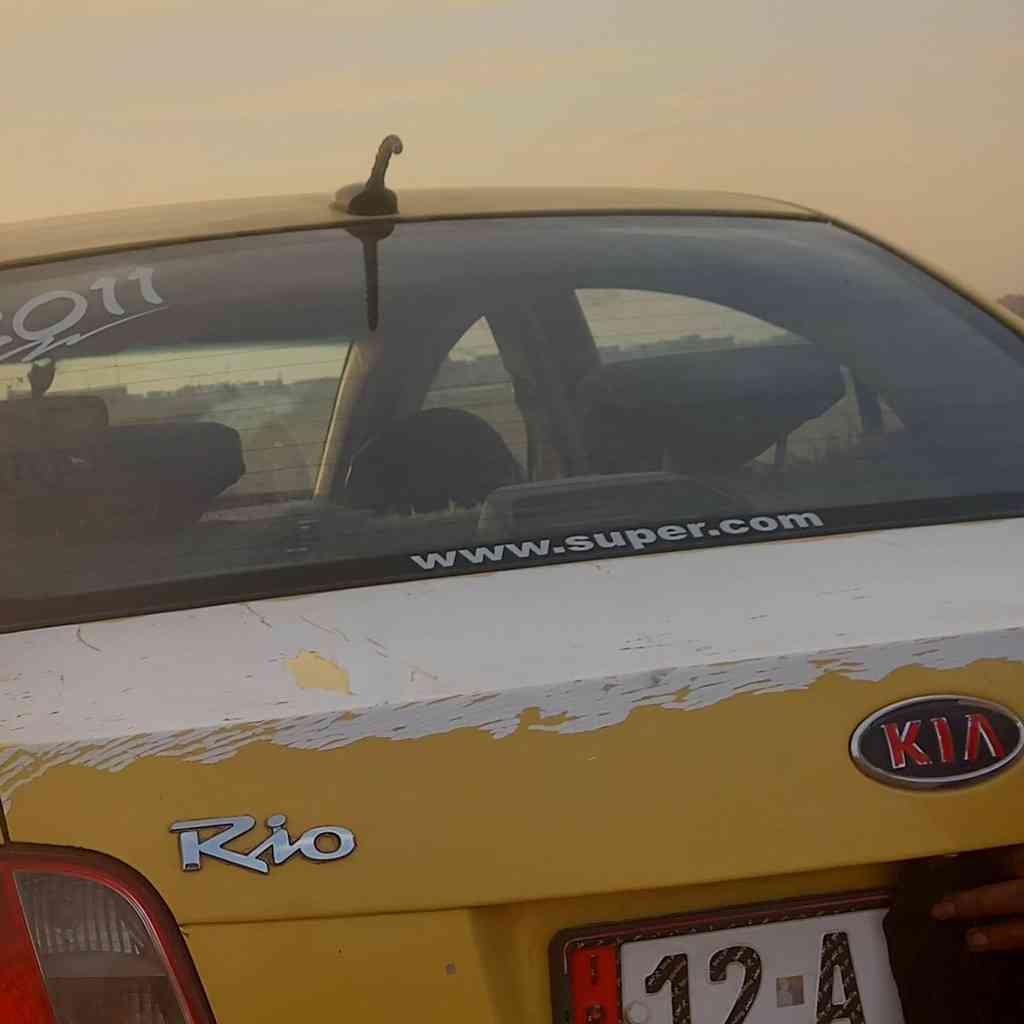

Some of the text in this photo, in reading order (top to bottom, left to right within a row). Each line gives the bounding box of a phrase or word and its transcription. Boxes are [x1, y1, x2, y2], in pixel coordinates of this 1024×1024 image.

[410, 509, 825, 571] www.super.com
[880, 713, 1007, 769] KIA
[169, 813, 358, 875] Rio
